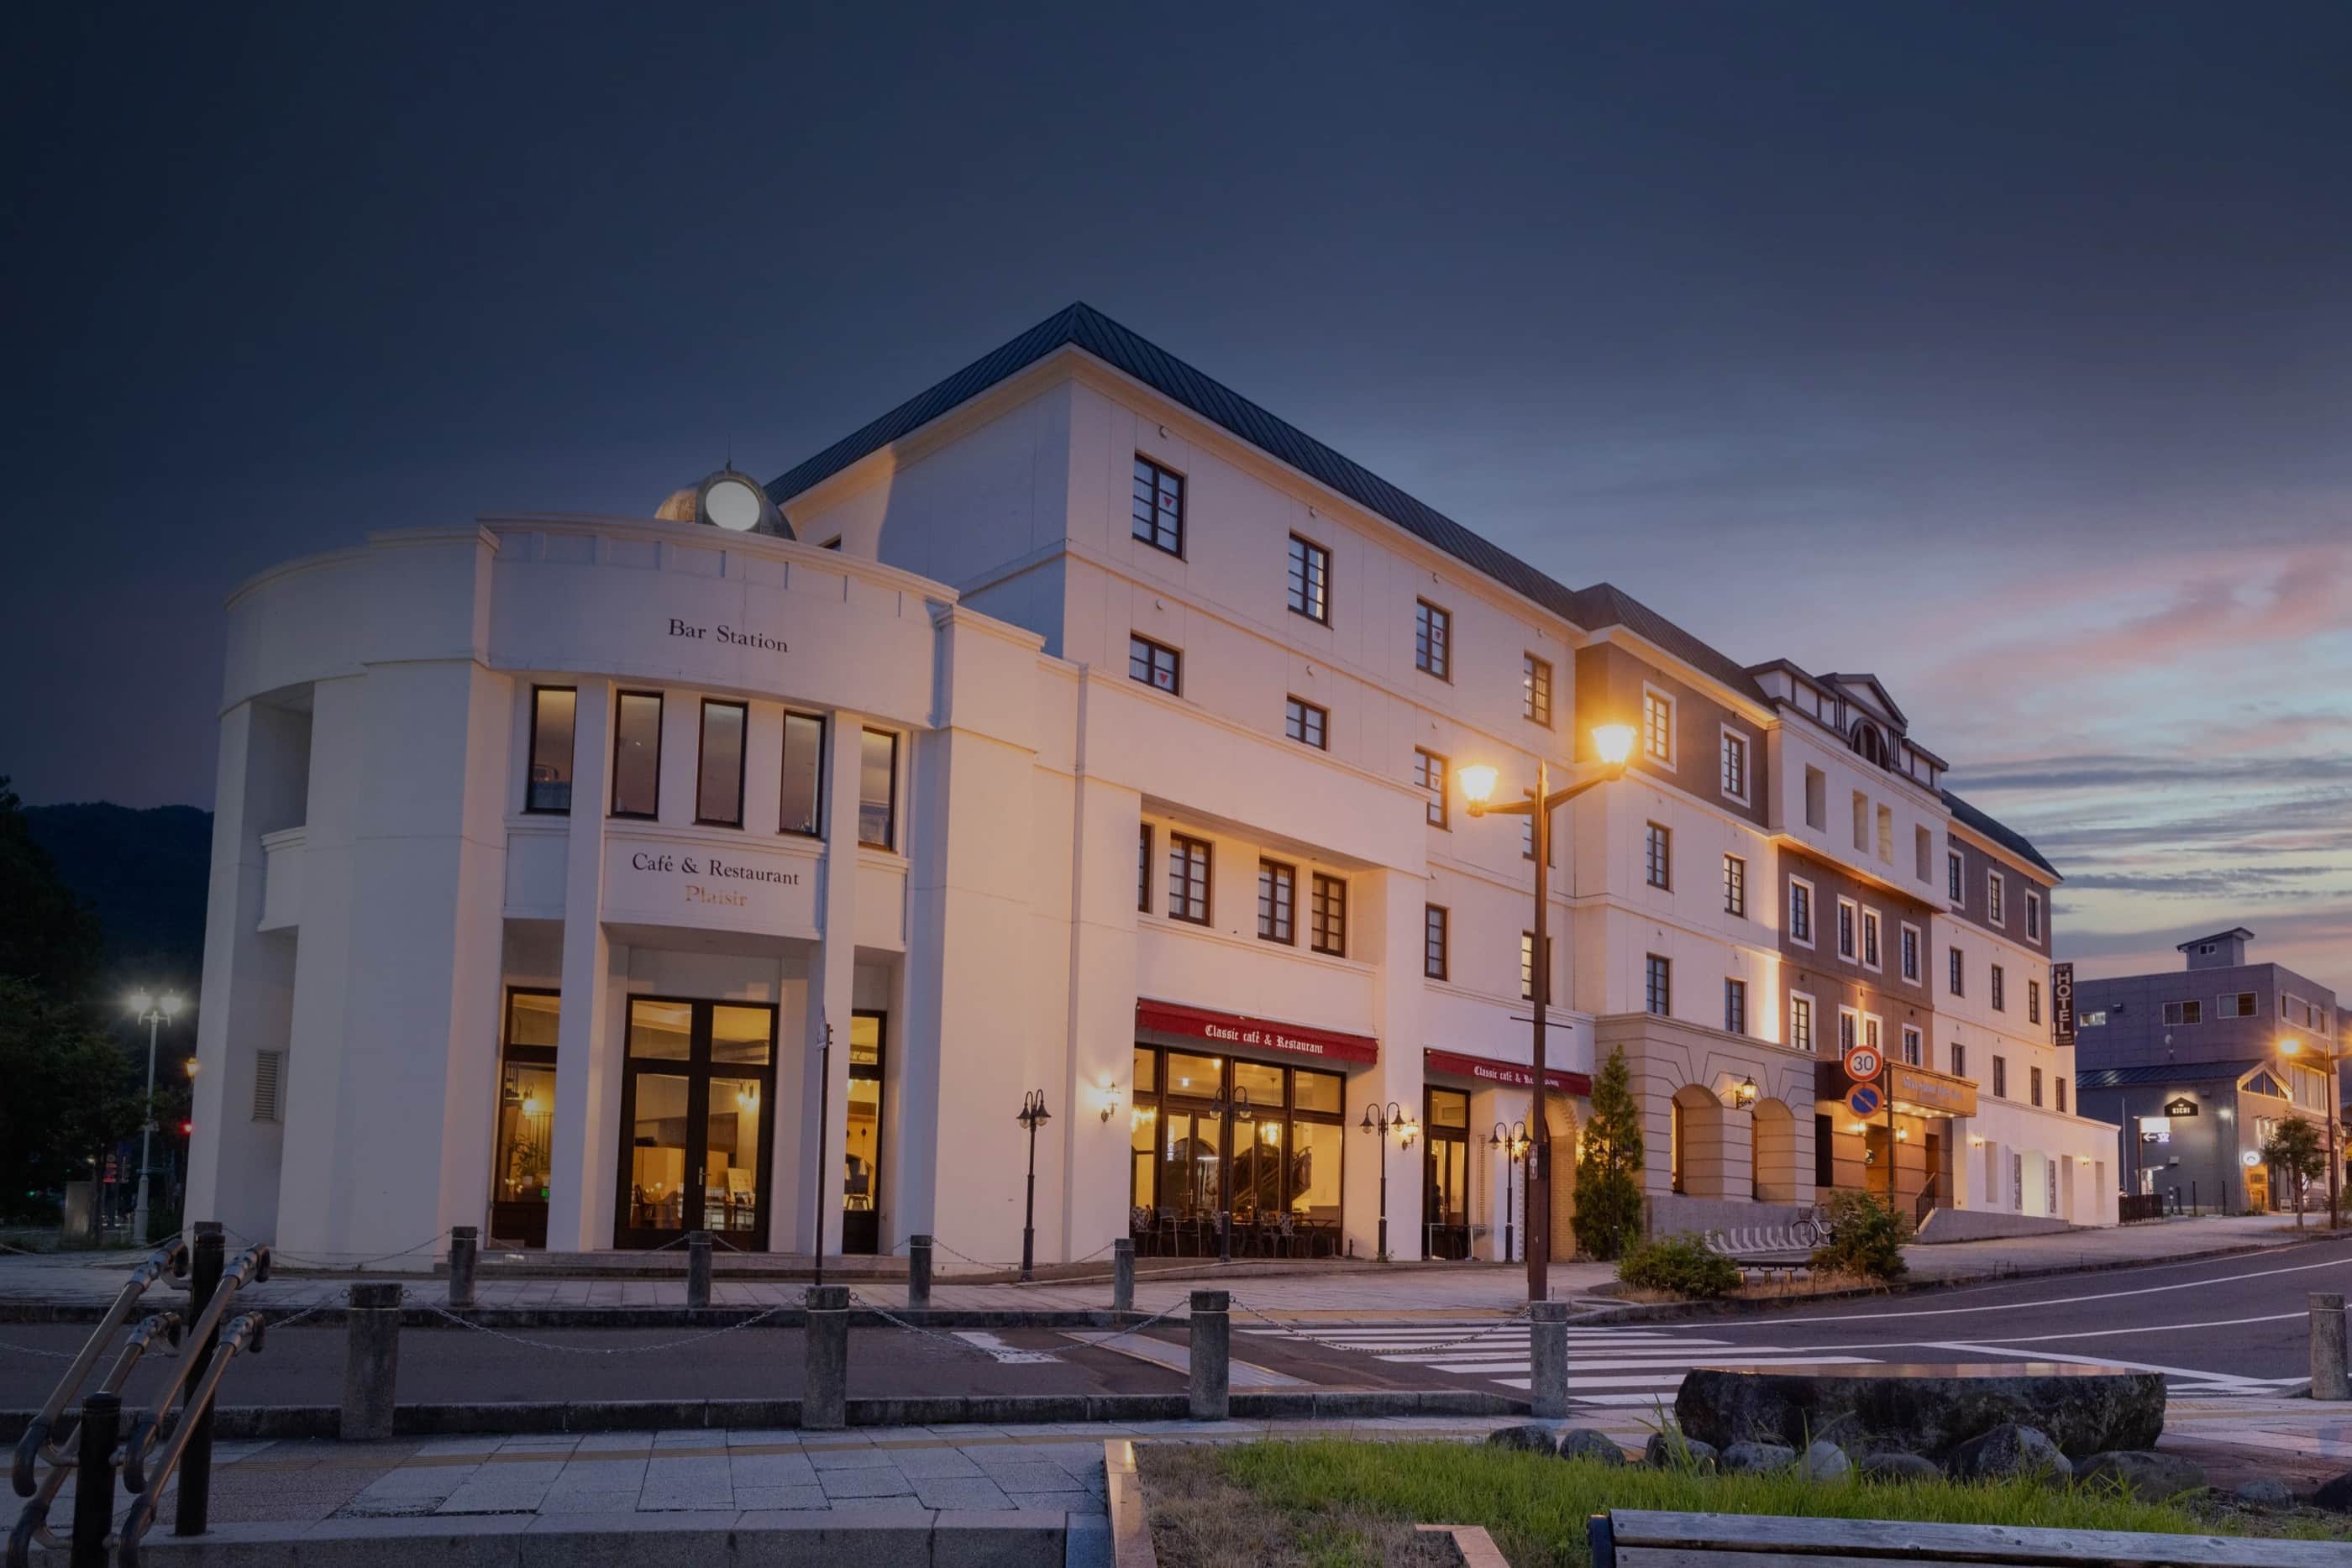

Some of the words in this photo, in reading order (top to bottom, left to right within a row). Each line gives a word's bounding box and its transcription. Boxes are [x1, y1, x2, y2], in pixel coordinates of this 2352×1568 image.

[669, 618, 706, 639] Bar
[717, 624, 788, 653] Station
[633, 852, 673, 872] Café
[681, 857, 699, 874] &
[709, 859, 799, 885] Restaurant
[685, 885, 748, 907] Plaisir
[2056, 972, 2071, 1035] HOTEL
[1205, 1025, 1239, 1041] Classic
[1264, 1034, 1273, 1046] &
[1277, 1036, 1324, 1054] Restaurant
[1473, 1066, 1497, 1079] Classic
[1854, 1055, 1874, 1072] 30
